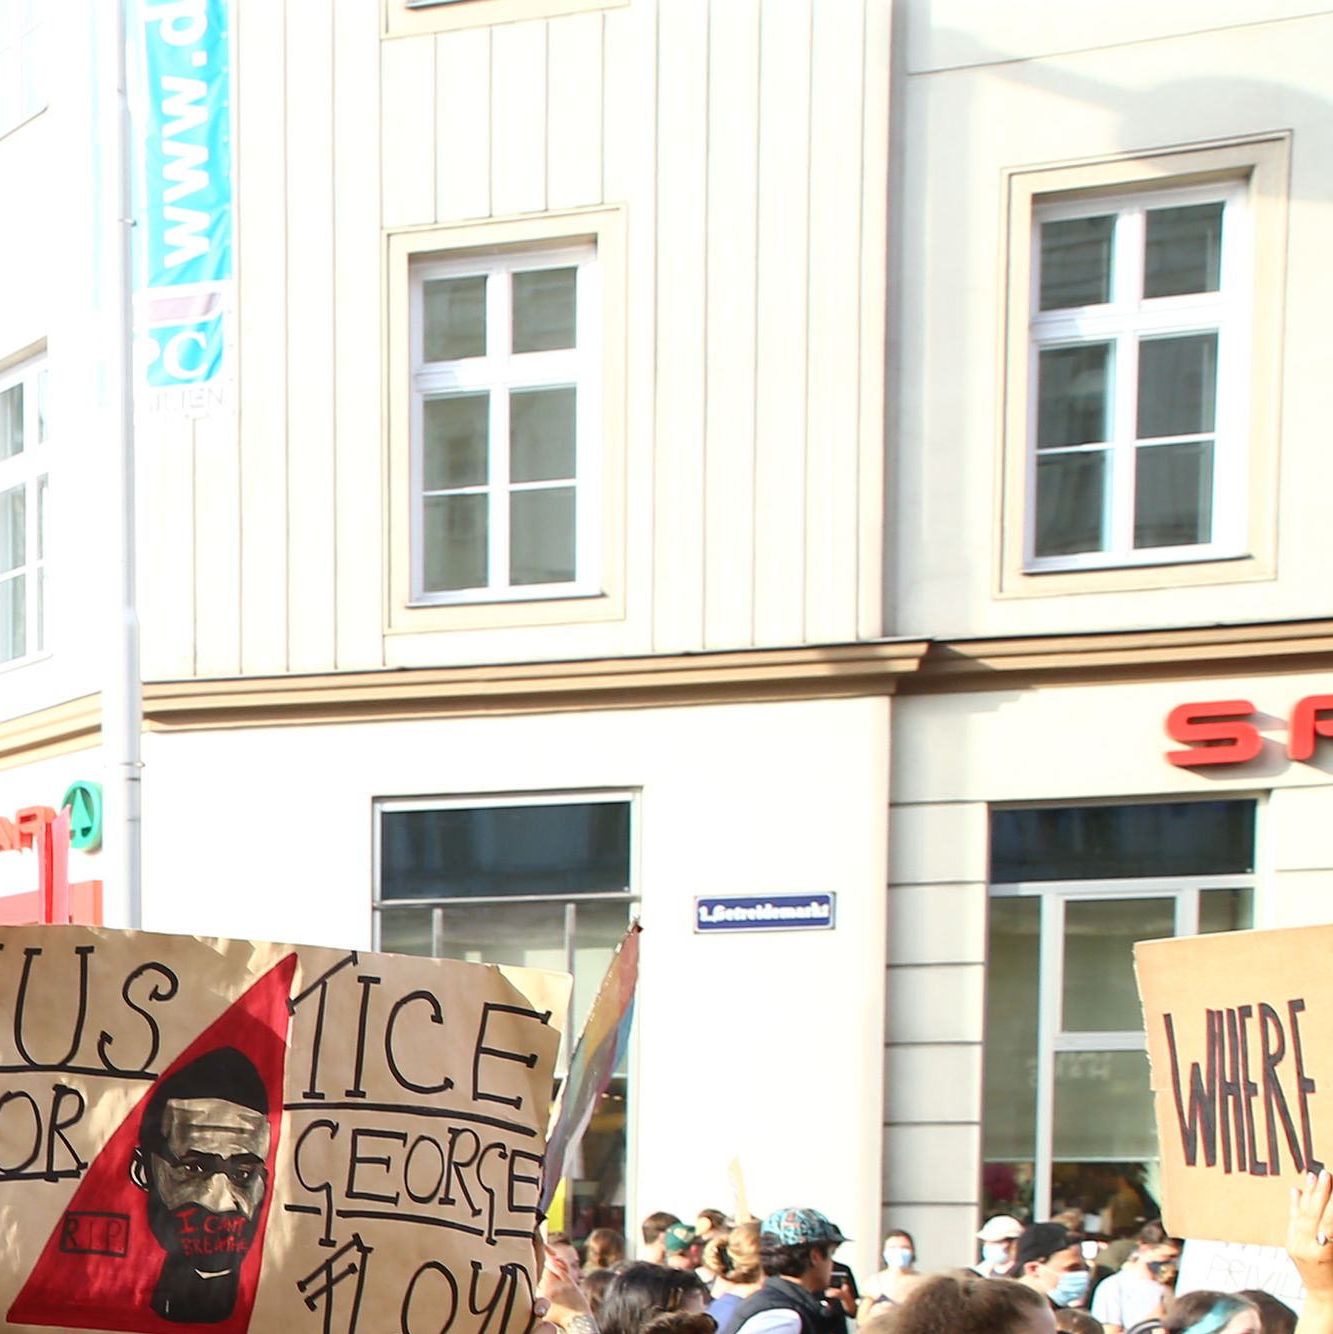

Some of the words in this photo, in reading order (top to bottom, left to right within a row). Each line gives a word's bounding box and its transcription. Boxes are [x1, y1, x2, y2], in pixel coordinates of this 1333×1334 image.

[288, 951, 552, 1109] TICE
[1162, 998, 1323, 1176] WHERE
[293, 1119, 545, 1247] GEORGE
